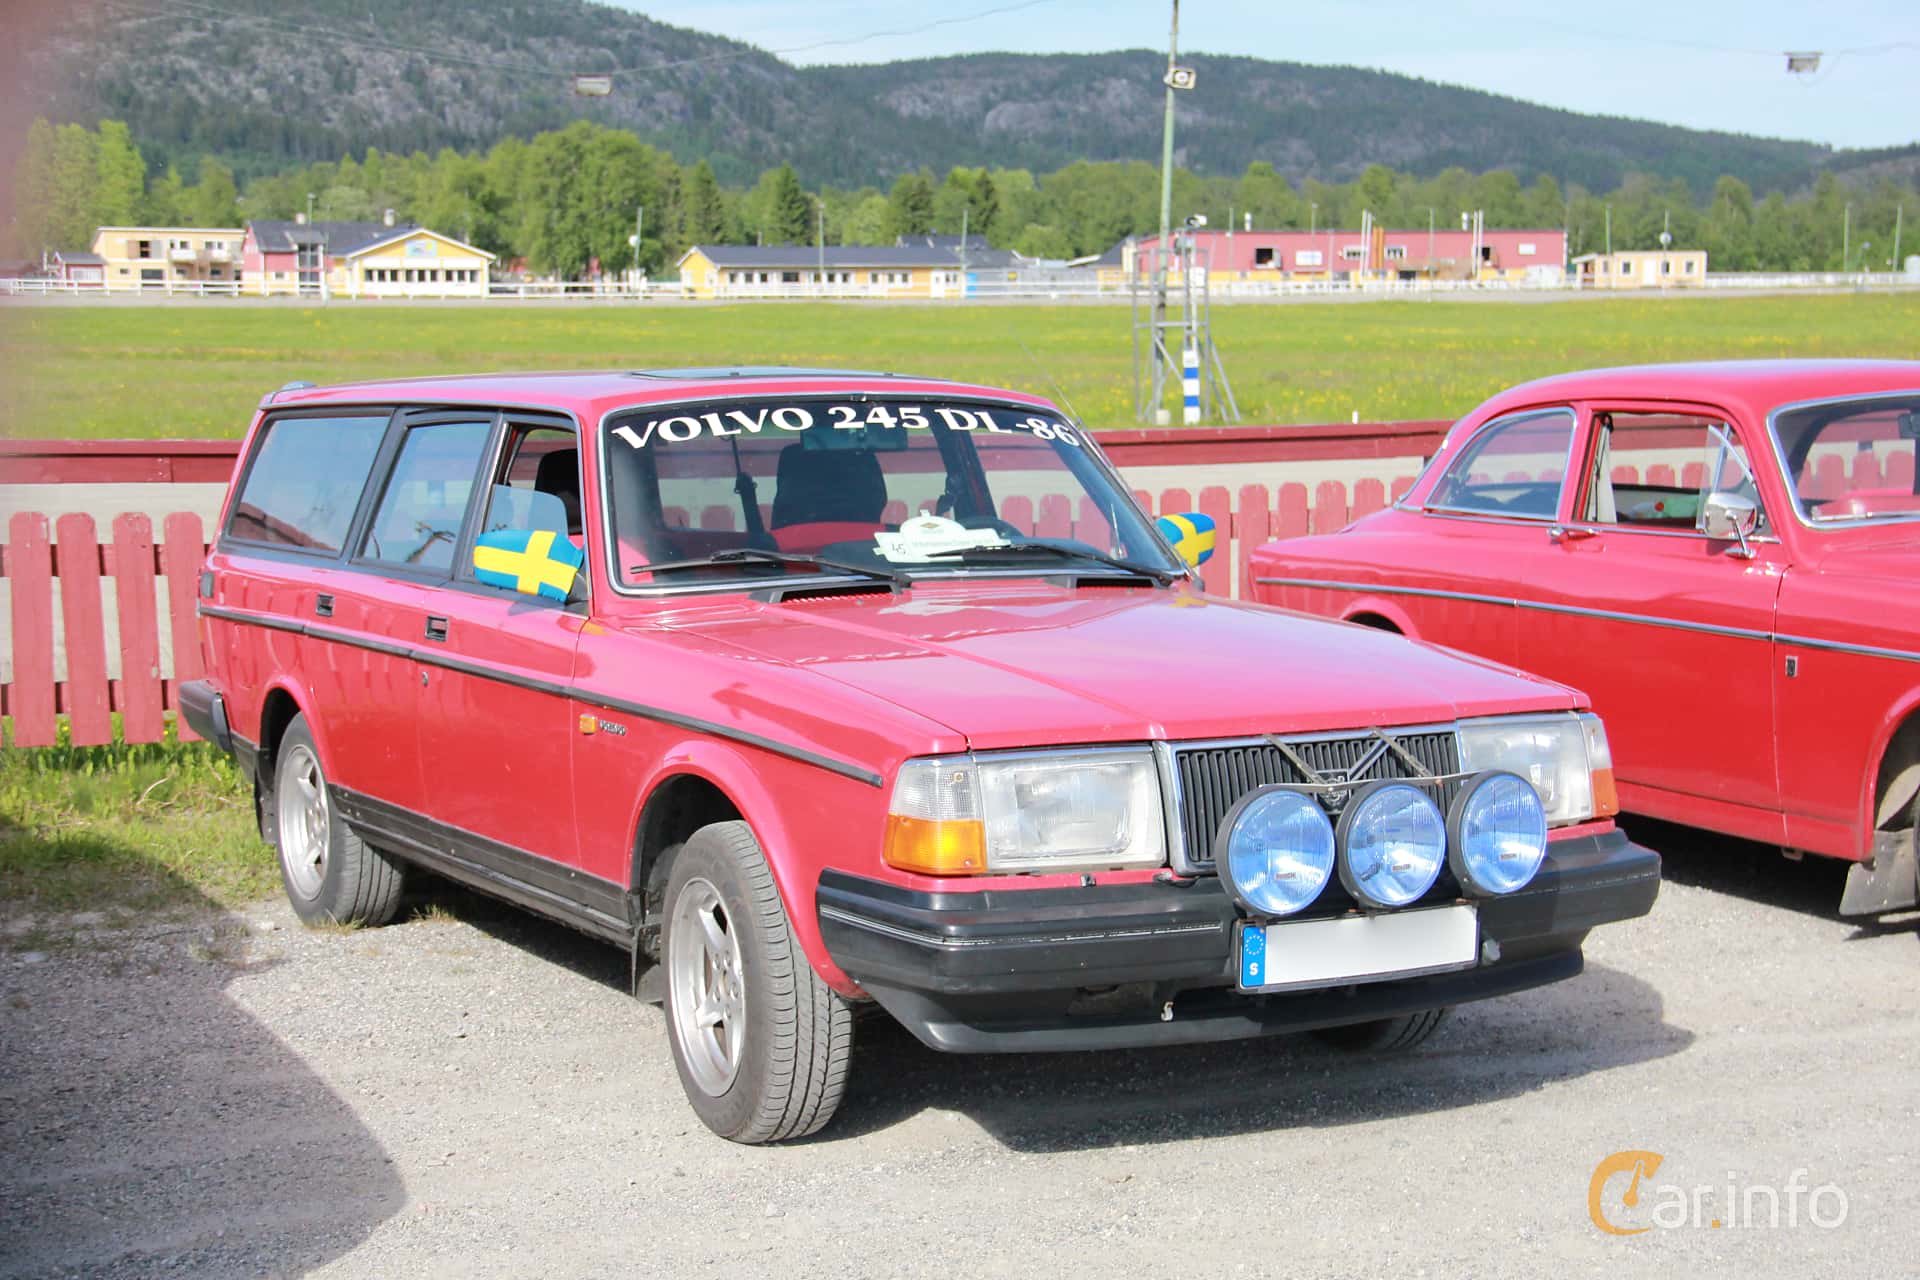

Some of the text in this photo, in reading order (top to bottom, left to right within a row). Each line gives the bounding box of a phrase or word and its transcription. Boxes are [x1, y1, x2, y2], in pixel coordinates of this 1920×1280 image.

[611, 407, 814, 449] VOLVO
[827, 406, 930, 429] 245
[934, 408, 1013, 434] DL
[1249, 962, 1259, 976] S
